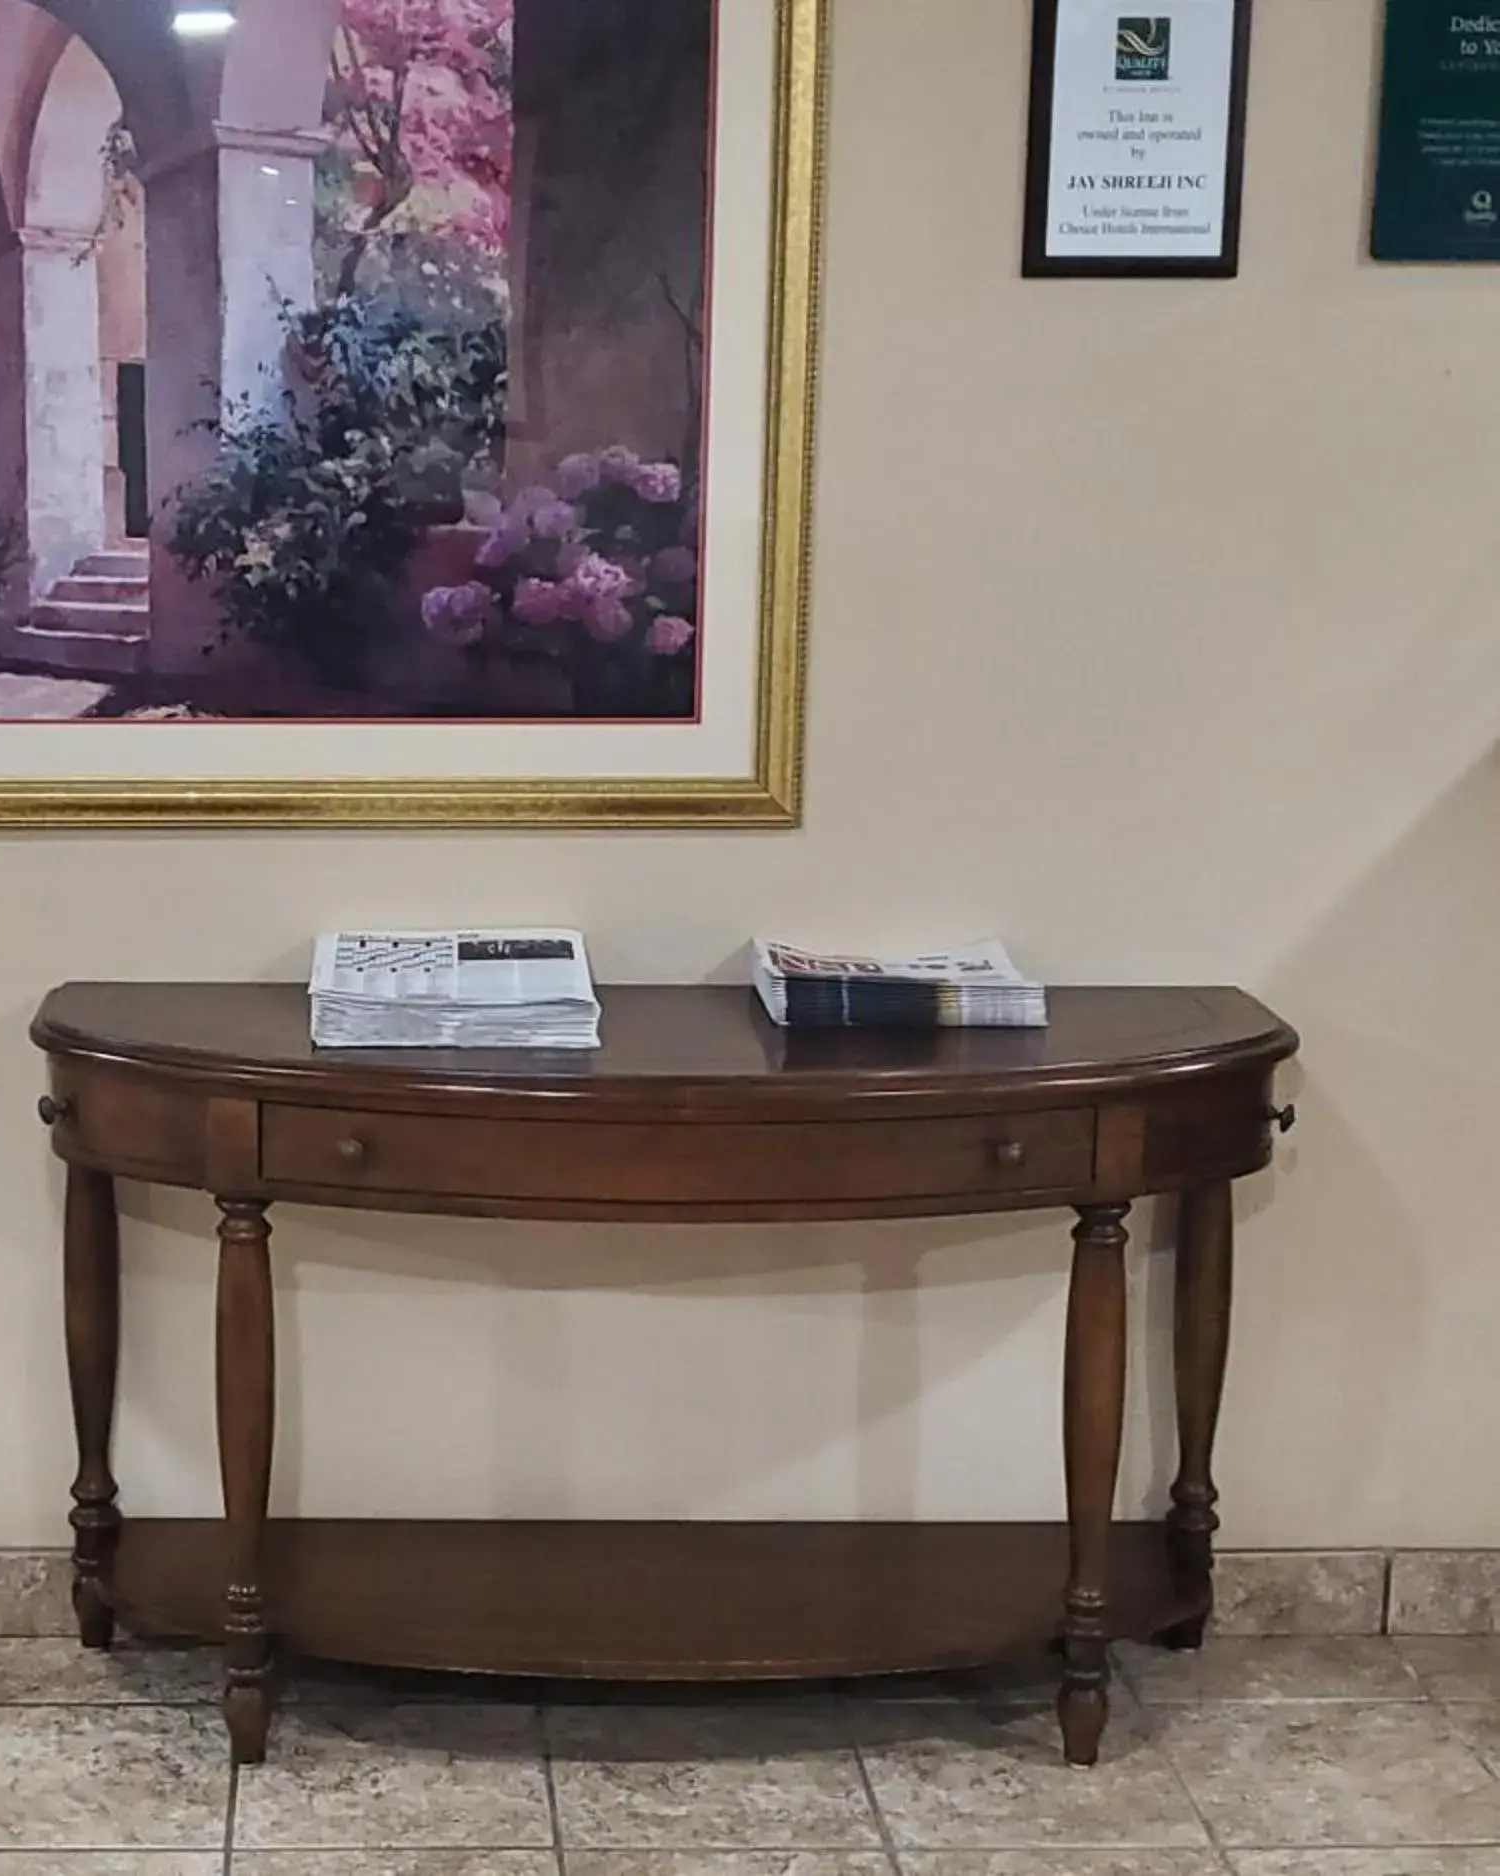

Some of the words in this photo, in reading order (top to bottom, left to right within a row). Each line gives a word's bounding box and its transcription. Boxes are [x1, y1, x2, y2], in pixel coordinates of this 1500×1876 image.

[1461, 39, 1478, 54] to
[1077, 128, 1119, 141] owned
[1122, 128, 1145, 141] and
[1148, 128, 1202, 144] operated
[1130, 147, 1146, 160] by
[1067, 175, 1096, 190] JAY
[1177, 175, 1207, 190] INC
